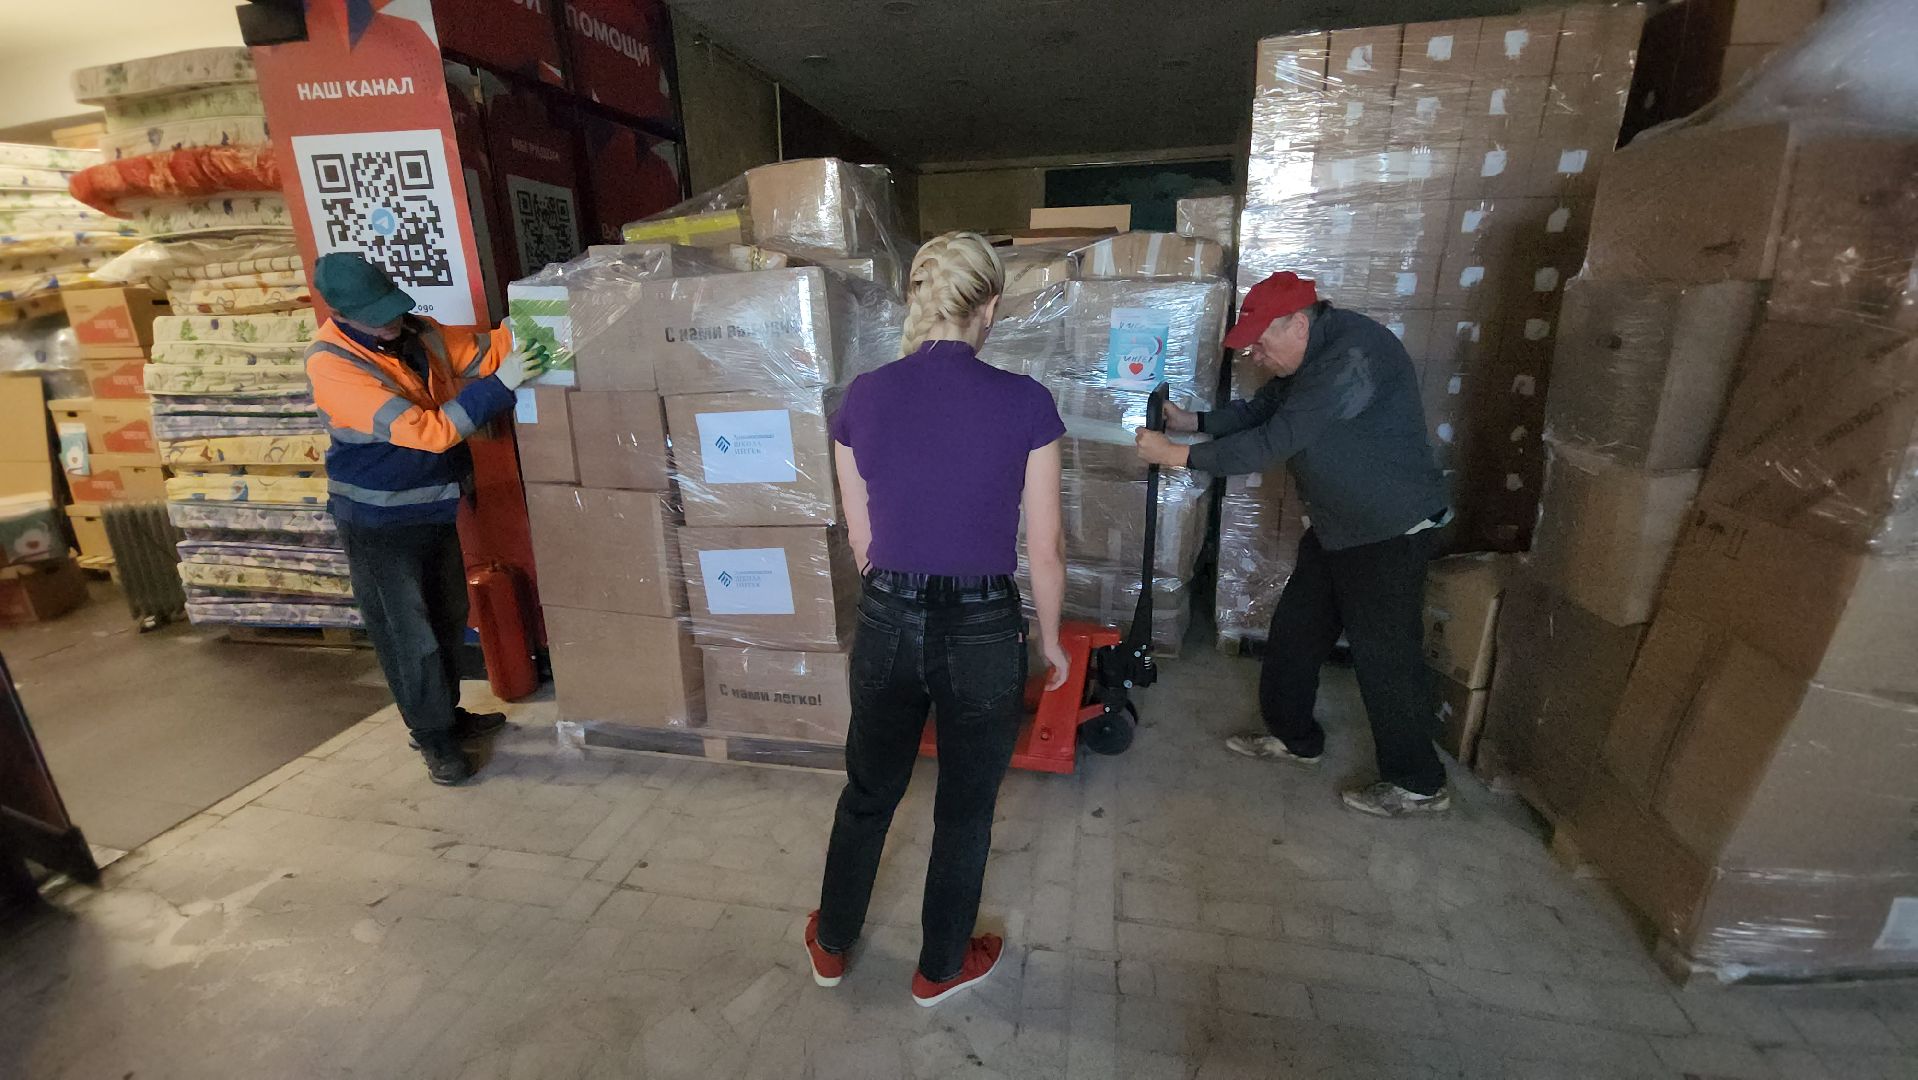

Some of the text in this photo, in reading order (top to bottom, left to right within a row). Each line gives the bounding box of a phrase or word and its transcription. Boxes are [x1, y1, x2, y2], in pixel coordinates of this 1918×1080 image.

[565, 4, 650, 67] ПОМОЩИ
[297, 77, 414, 100] НАШ КАНАЛ
[665, 327, 675, 343] С
[680, 325, 722, 342] нами
[719, 683, 822, 706] С нами легко!
